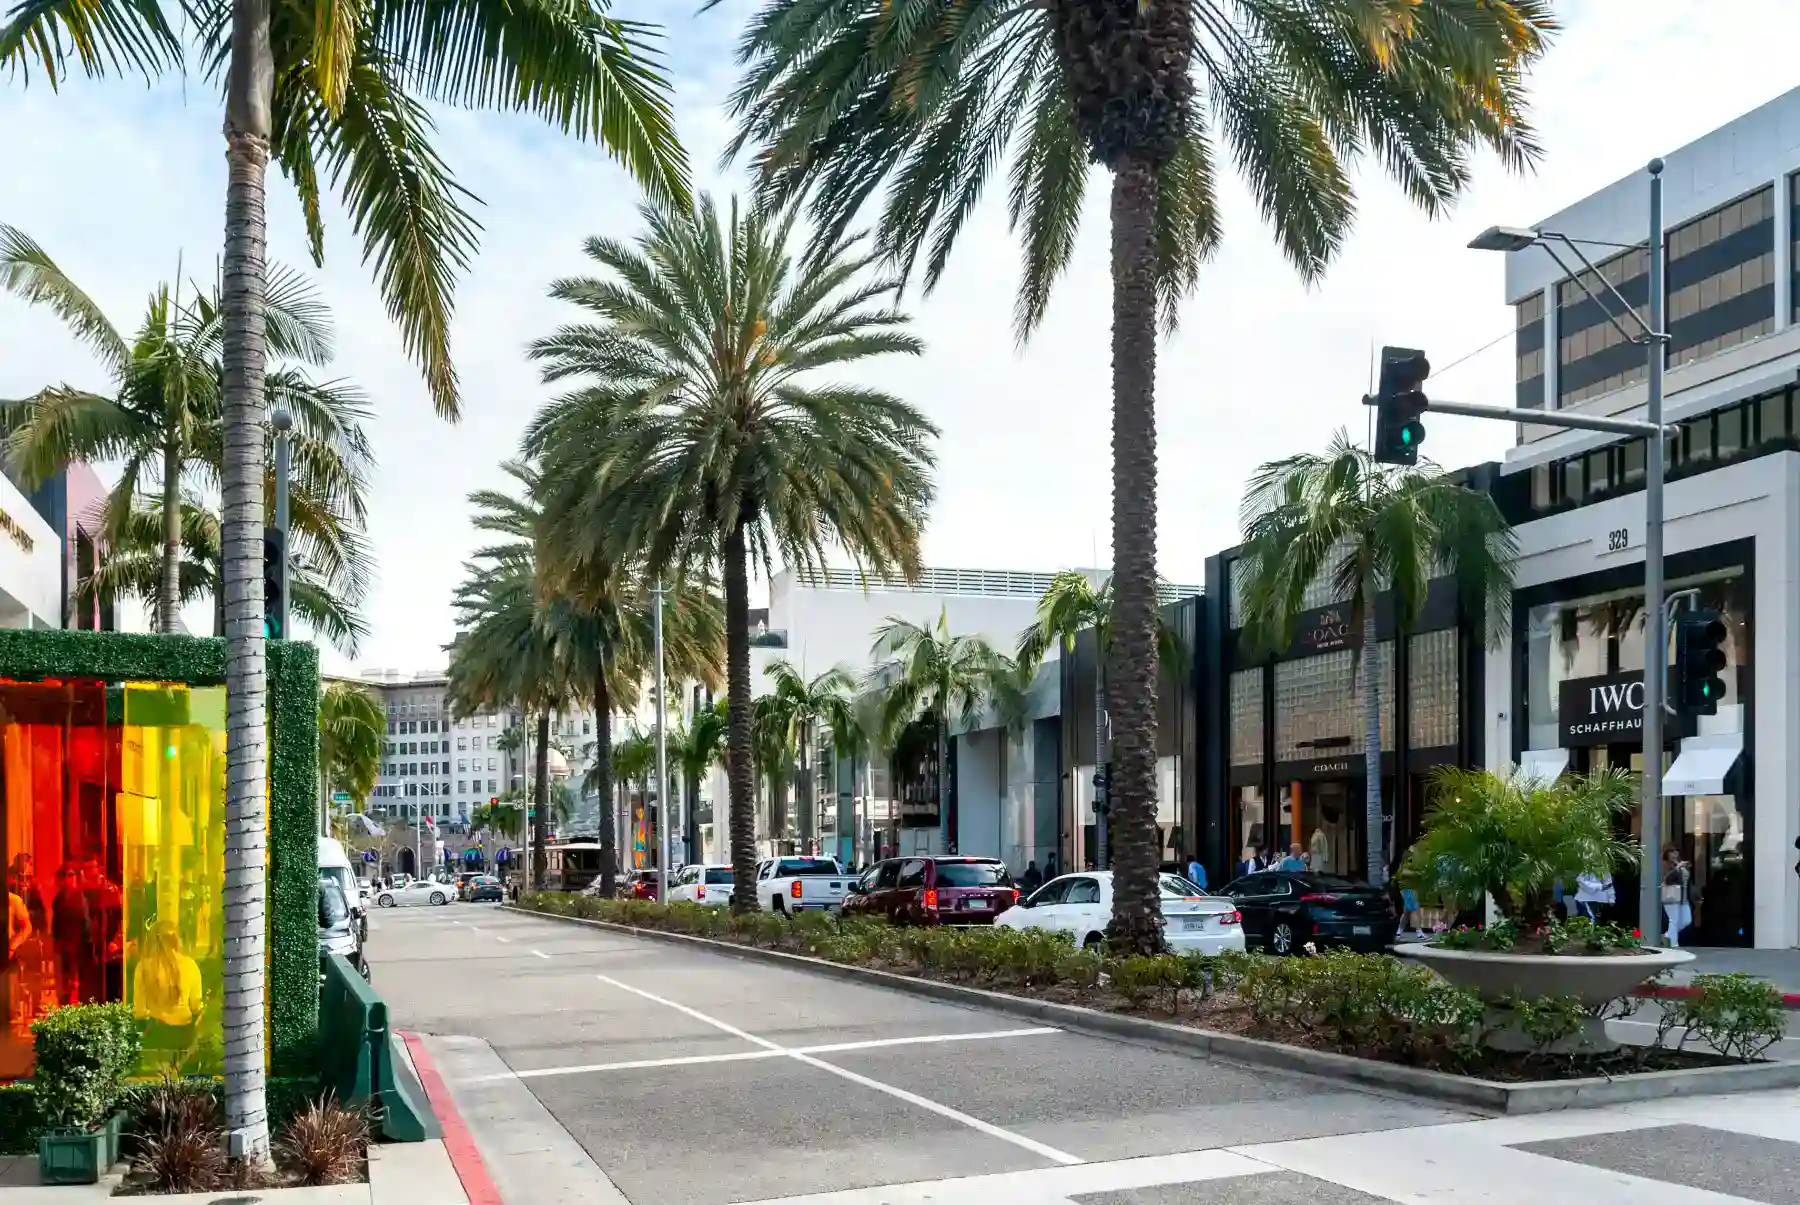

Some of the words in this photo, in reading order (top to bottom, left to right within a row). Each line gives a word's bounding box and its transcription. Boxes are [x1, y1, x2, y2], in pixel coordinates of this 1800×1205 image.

[1609, 528, 1628, 551] 329
[1589, 681, 1645, 715] IWC
[1569, 718, 1643, 735] SCHAFFHAU
[1313, 762, 1348, 773] COACH
